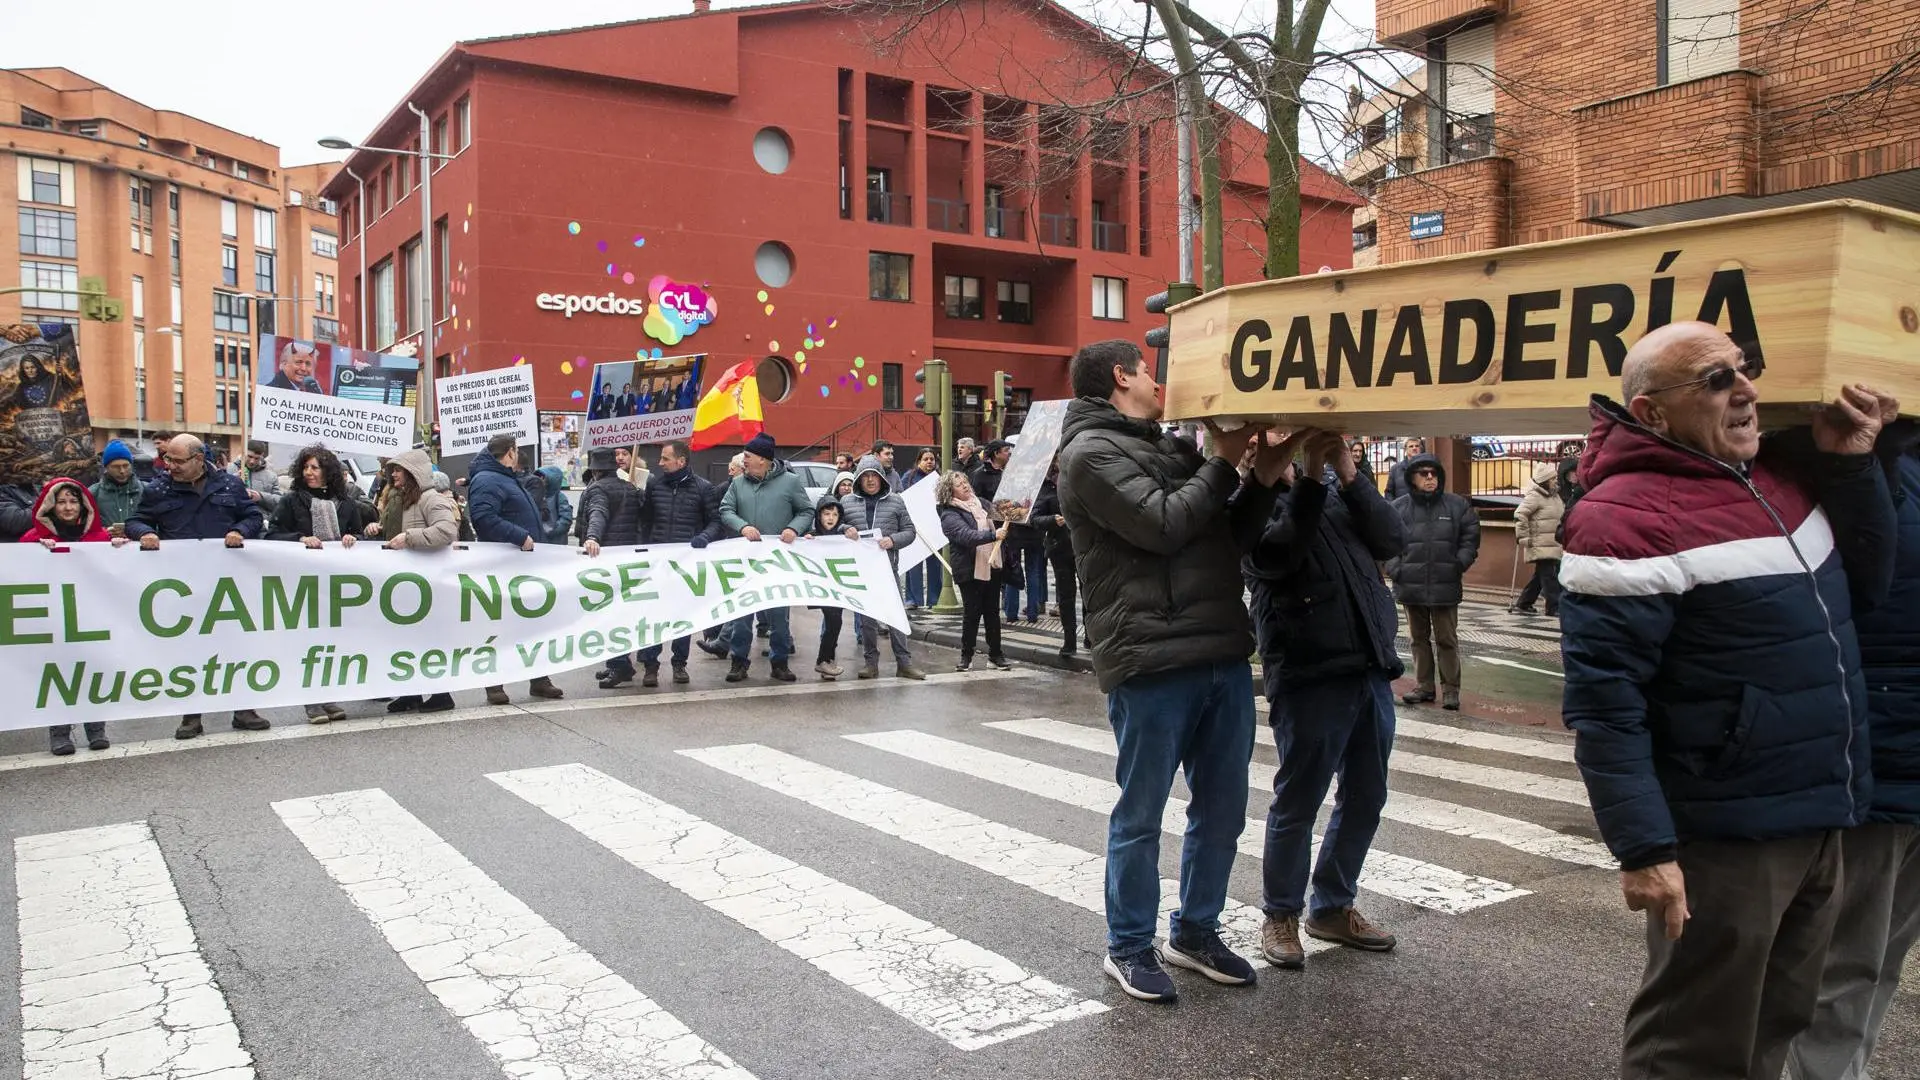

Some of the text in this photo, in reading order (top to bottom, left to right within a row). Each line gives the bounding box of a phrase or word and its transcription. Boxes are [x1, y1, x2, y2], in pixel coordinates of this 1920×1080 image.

[535, 292, 643, 318] espacios
[678, 310, 707, 323] digital
[1230, 250, 1766, 392] GANADERÍA
[440, 396, 454, 404] POR
[463, 392, 482, 401] SUELO
[488, 388, 500, 397] LOS
[501, 384, 530, 395] INSUMOS
[446, 374, 522, 392] LOS PRECIOS DEL CEREAL
[260, 396, 406, 425] NO AL HUMILLANTE PACTO
[440, 408, 452, 416] POR
[454, 406, 460, 414] EL
[484, 400, 496, 409] LAS
[496, 394, 533, 406] DECISIONES
[483, 412, 490, 420] AL
[492, 408, 523, 418] RESPECTO
[265, 420, 398, 446] EN ESTAS CONDICIONES
[270, 410, 396, 435] COMERCIAL CON EEUU
[458, 426, 478, 436] MALAS
[589, 414, 693, 436] NO AL ACUERDO CON
[654, 426, 670, 438] ASÍ
[672, 426, 686, 436] NO
[452, 438, 470, 448] RUINA
[0, 548, 868, 646] EL CAMPO NO SE VENDE
[36, 653, 281, 709] Nuestro
[300, 645, 369, 688] fin
[387, 635, 498, 682] será
[516, 616, 694, 668] vuestra
